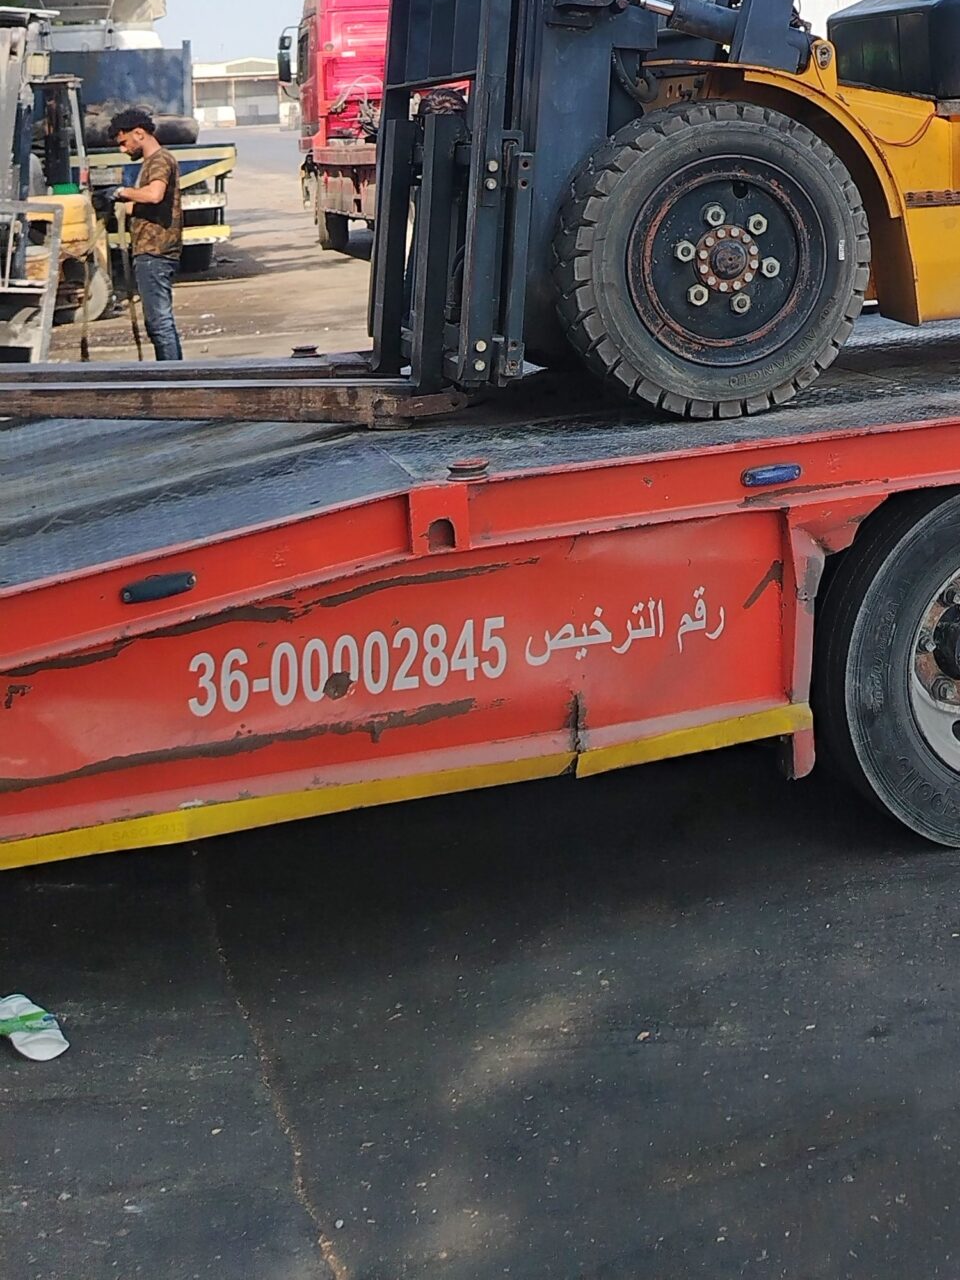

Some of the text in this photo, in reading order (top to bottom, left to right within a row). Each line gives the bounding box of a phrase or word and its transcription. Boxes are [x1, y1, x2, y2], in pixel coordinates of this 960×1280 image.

[188, 586, 726, 717] رقم الترخيص 36-00002845
[112, 827, 149, 841] SASO
